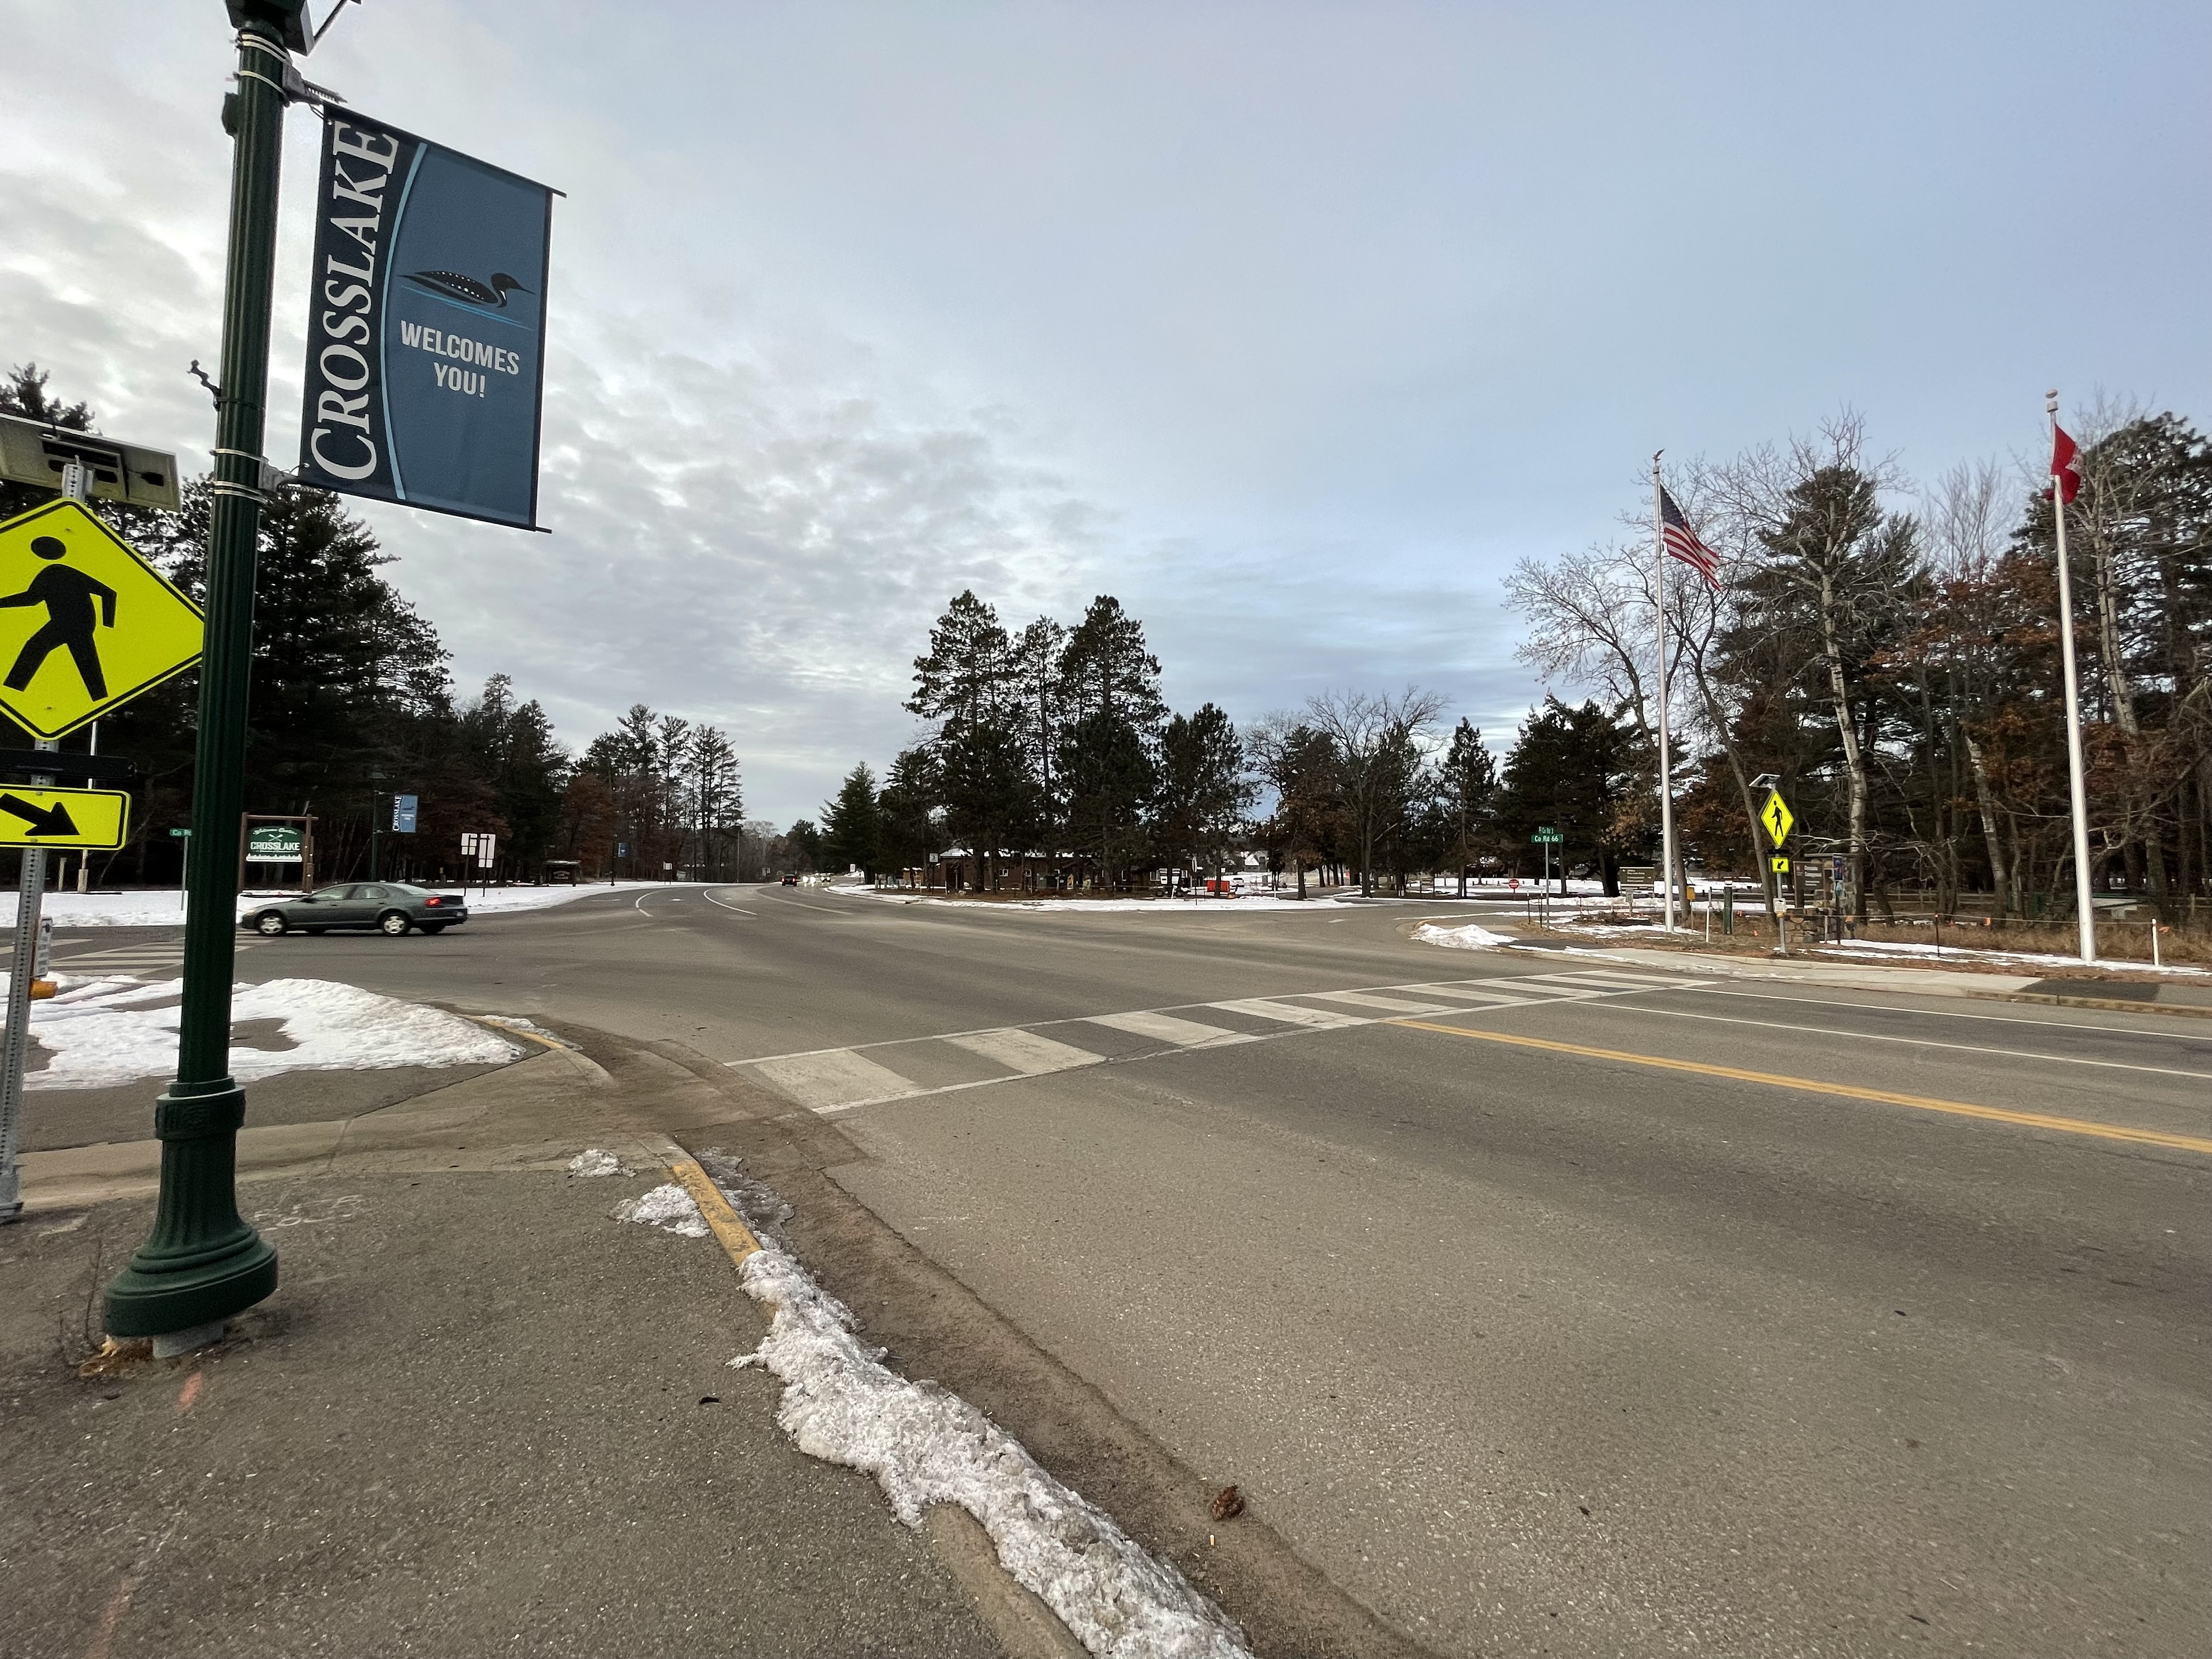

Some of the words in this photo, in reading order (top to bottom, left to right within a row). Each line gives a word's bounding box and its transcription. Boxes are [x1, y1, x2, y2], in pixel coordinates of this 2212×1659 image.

[310, 121, 400, 481] CROSSLAKE
[399, 320, 520, 375] WELCOMES
[433, 362, 487, 399] YOU!
[392, 795, 402, 831] CROSSLAKE
[250, 841, 301, 850] CROSSLAKE
